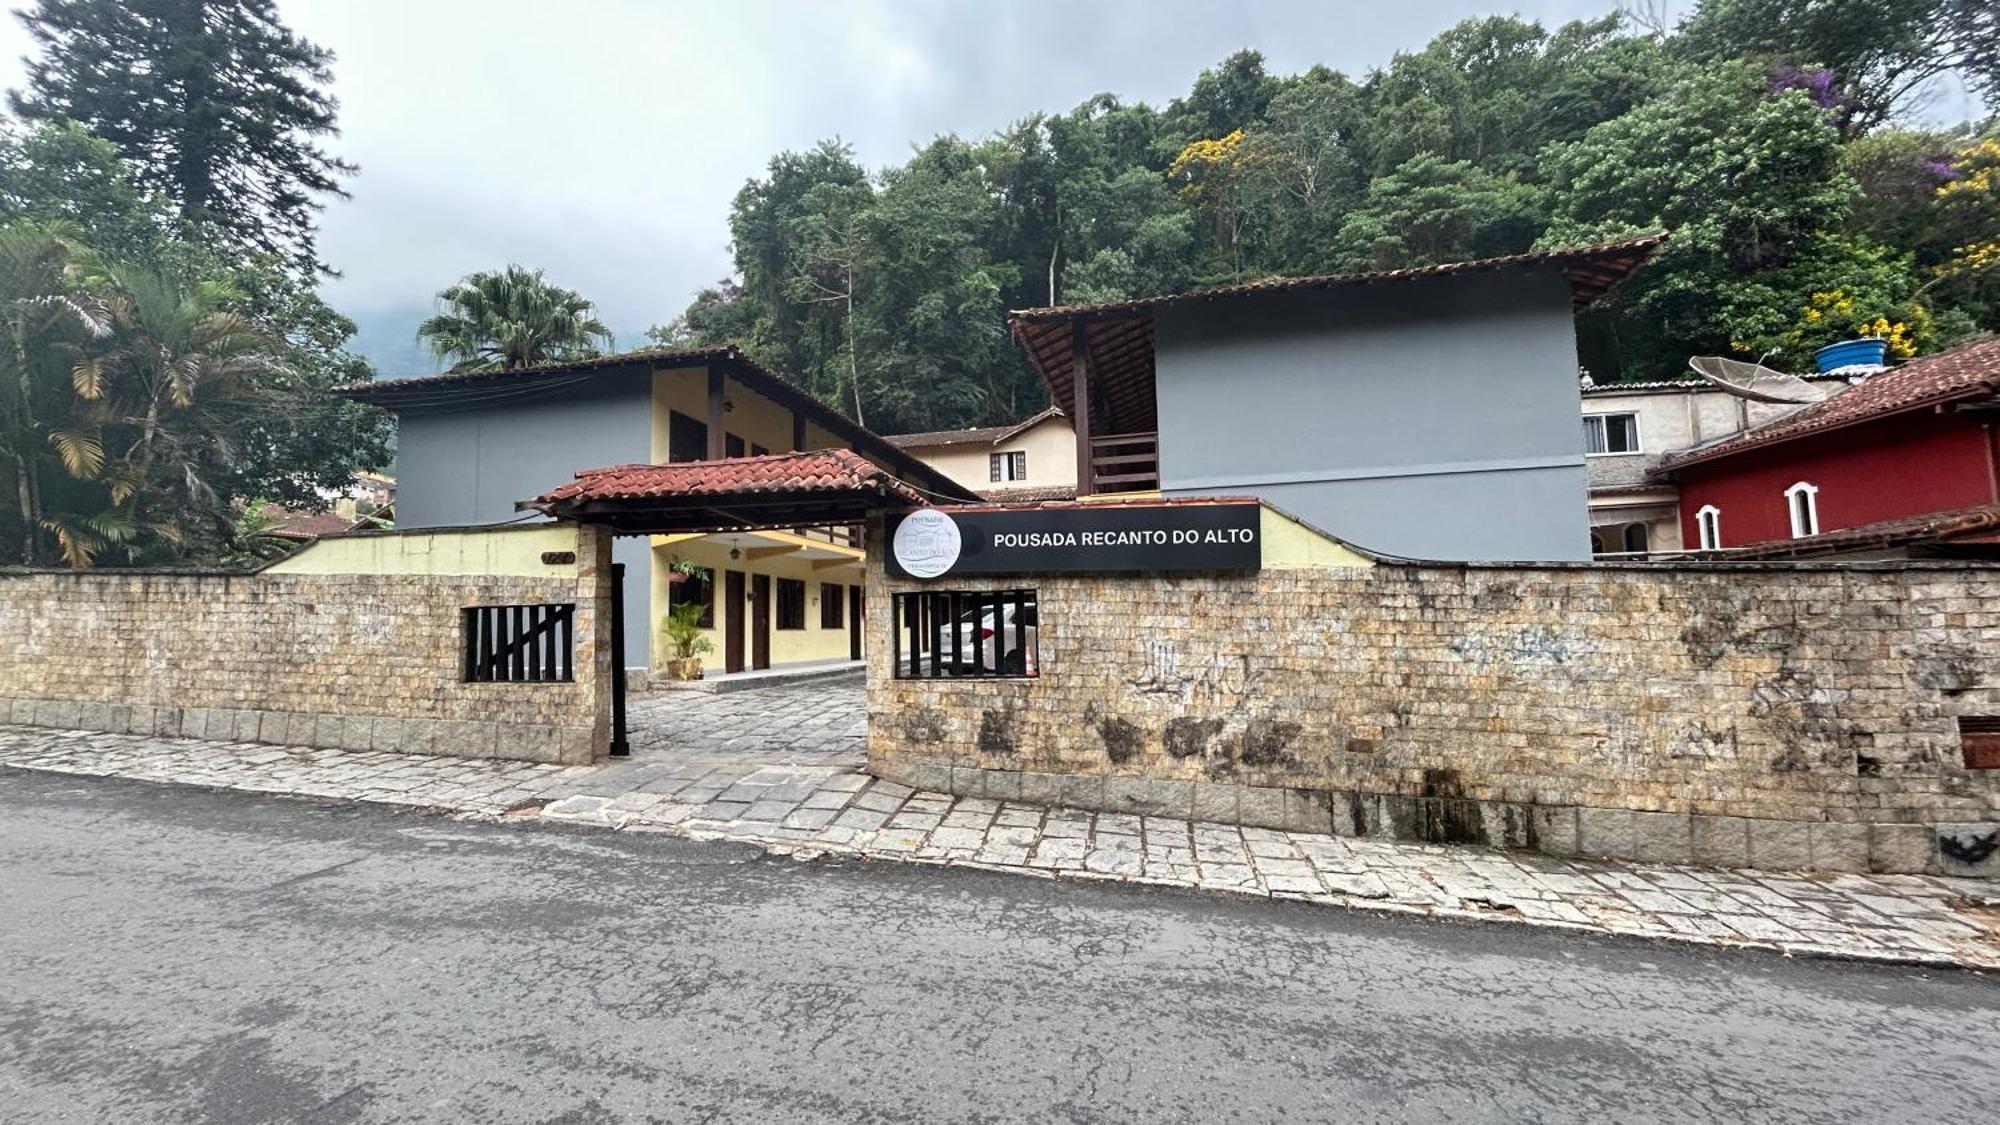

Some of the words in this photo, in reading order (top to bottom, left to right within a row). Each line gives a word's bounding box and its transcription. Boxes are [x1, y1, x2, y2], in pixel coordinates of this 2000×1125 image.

[994, 532, 1076, 548] POUSADA
[1081, 530, 1166, 546] RECANTO
[1173, 529, 1200, 545] DO
[1204, 528, 1253, 544] ALTO
